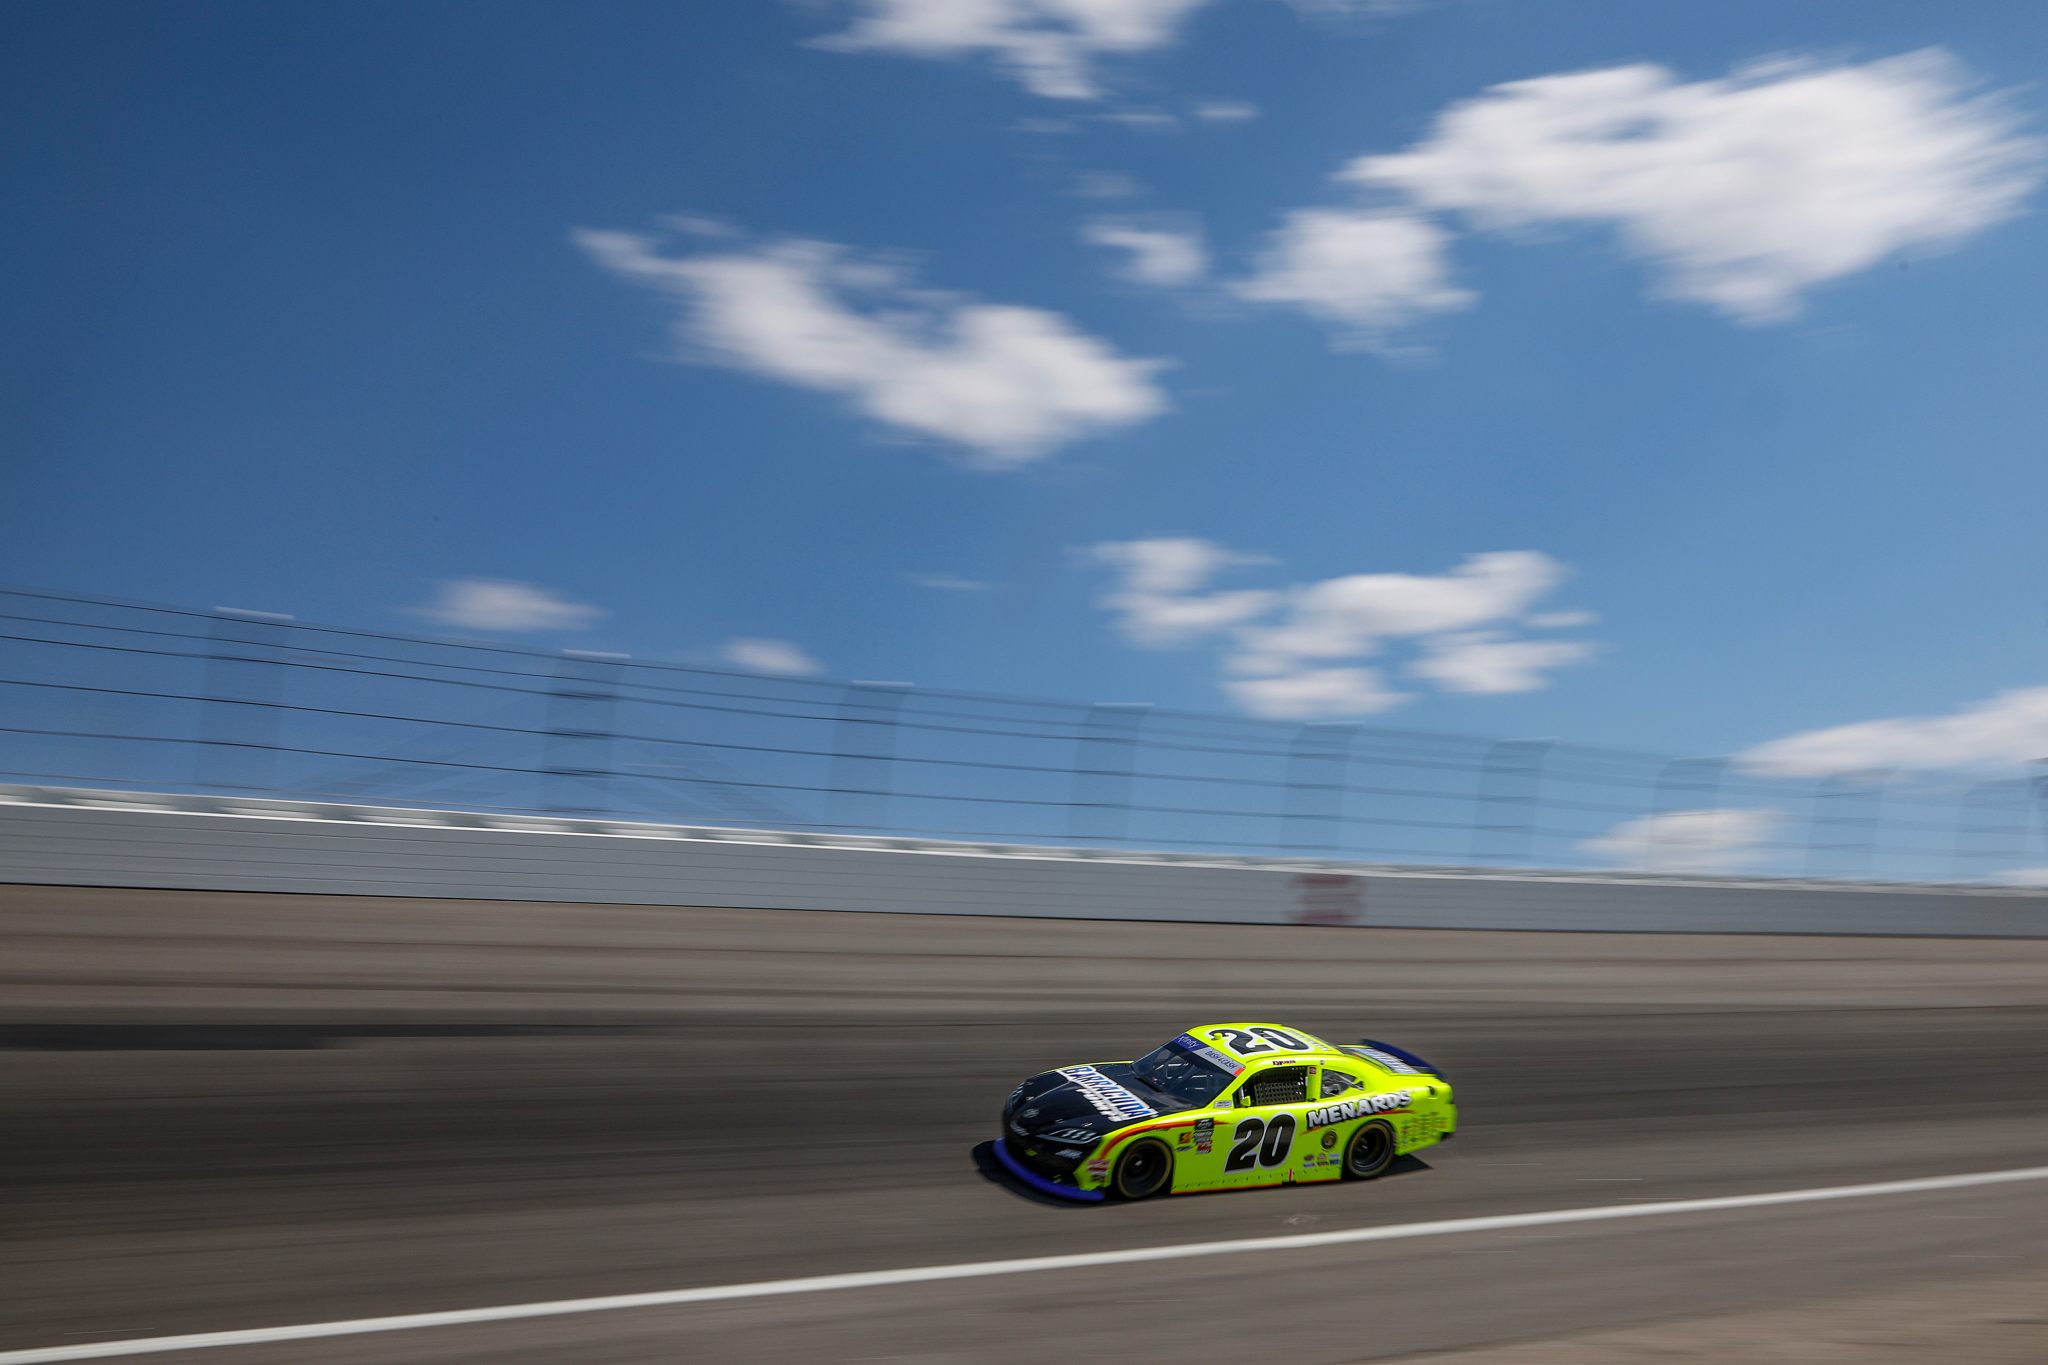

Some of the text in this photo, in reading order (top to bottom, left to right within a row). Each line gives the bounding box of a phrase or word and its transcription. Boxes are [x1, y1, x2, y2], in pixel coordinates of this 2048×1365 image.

[1207, 1027, 1311, 1055] 20
[1306, 1090, 1412, 1131] MENARDS
[1224, 1113, 1296, 1173] 20
